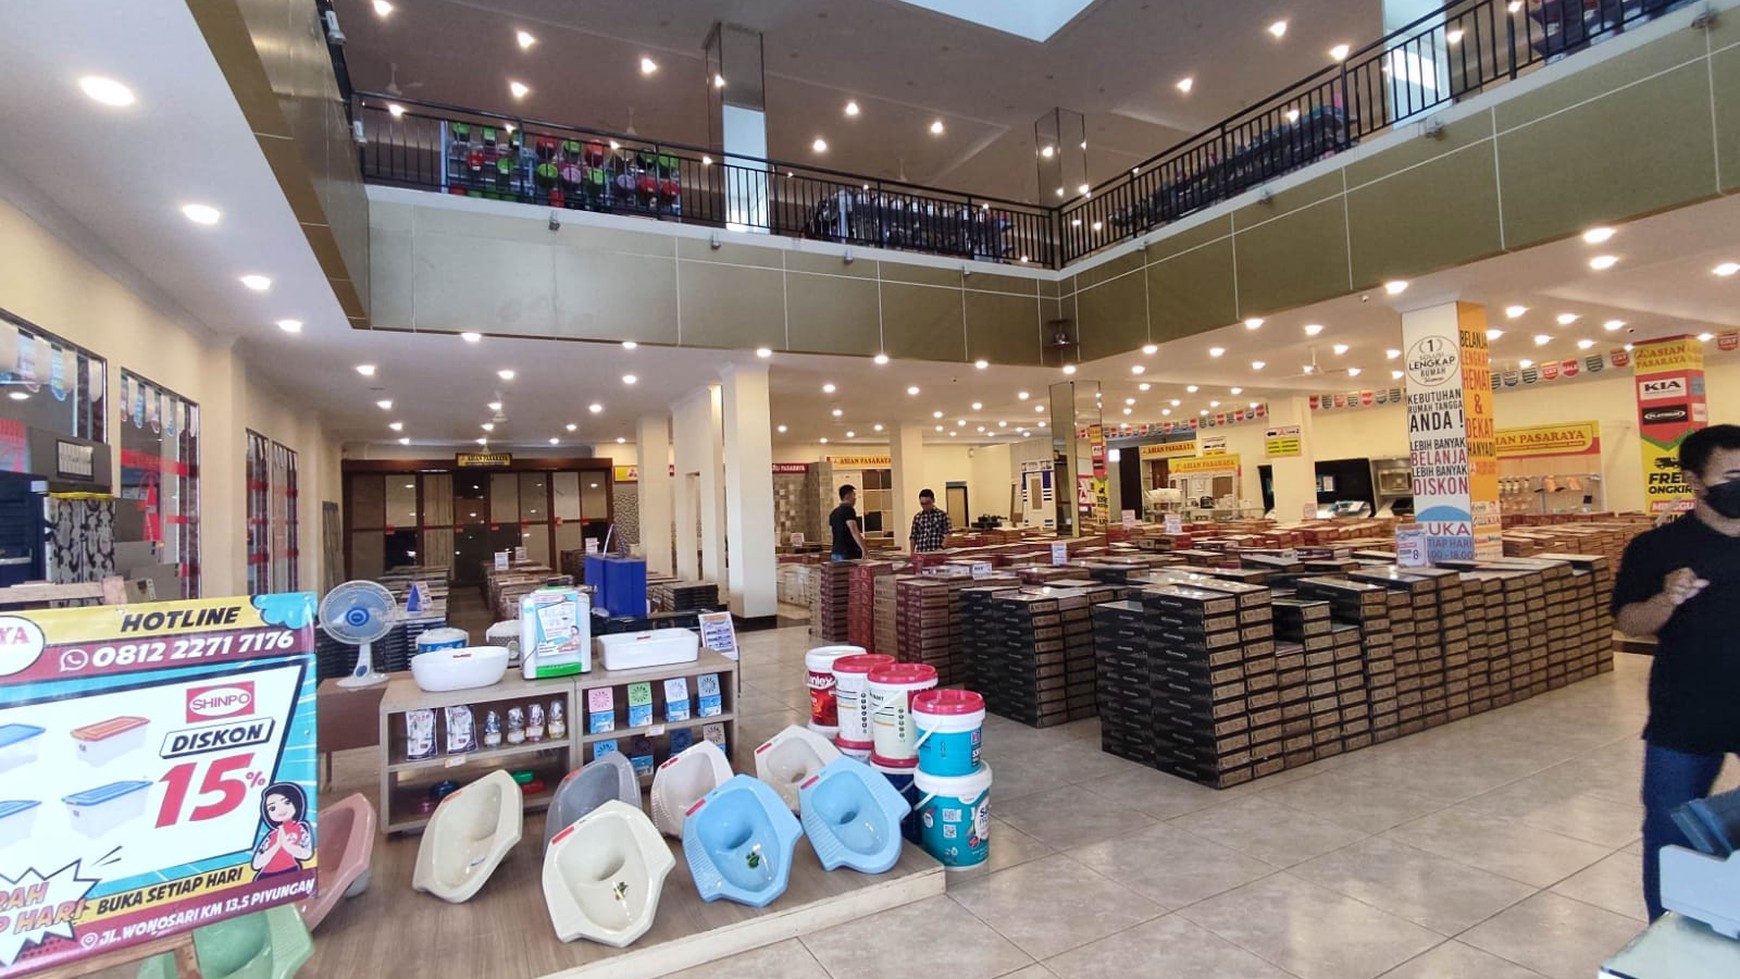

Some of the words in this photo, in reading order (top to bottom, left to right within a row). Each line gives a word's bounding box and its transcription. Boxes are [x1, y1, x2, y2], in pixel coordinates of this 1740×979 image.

[1460, 330, 1488, 349] BELANJA
[1649, 345, 1685, 357] ASIAN
[1408, 355, 1455, 371] LENGKAP
[1636, 356, 1686, 368] PASARAYA
[1420, 367, 1446, 377] RUMAH
[1463, 369, 1490, 391] HEMAT
[1644, 381, 1681, 392] KIA
[1407, 388, 1461, 405] KEBUTUHAN
[1474, 393, 1482, 414] &
[1408, 404, 1432, 414] RUMAH
[1435, 400, 1463, 411] TANGGA
[1410, 411, 1452, 433] ANDA
[1459, 409, 1464, 428] !
[1465, 418, 1493, 438] DEKAT
[1410, 441, 1432, 451] LEBIH
[1435, 437, 1466, 449] BANYAK
[1520, 430, 1585, 443] PASARAYA
[1411, 449, 1466, 466] BELANJA
[1412, 467, 1434, 477] LEBIH
[1436, 464, 1467, 476] BANYAK
[1649, 472, 1683, 484] FRE
[1413, 477, 1468, 496] DISKON
[1428, 522, 1471, 536] UKA
[120, 606, 241, 632] HOTLINE
[92, 642, 167, 668] 0812
[170, 636, 233, 660] 2271
[237, 630, 295, 654] 7176
[192, 692, 251, 711] SHINPO
[170, 723, 265, 753] DISKON
[154, 752, 255, 829] 15
[97, 898, 143, 915] BUKA
[146, 881, 202, 903] SETIAP
[205, 867, 243, 889] HARI
[13, 899, 86, 935] HARI
[123, 908, 198, 939] WONOSARI
[201, 902, 223, 919] KM
[251, 879, 315, 904] PIYUNGAN
